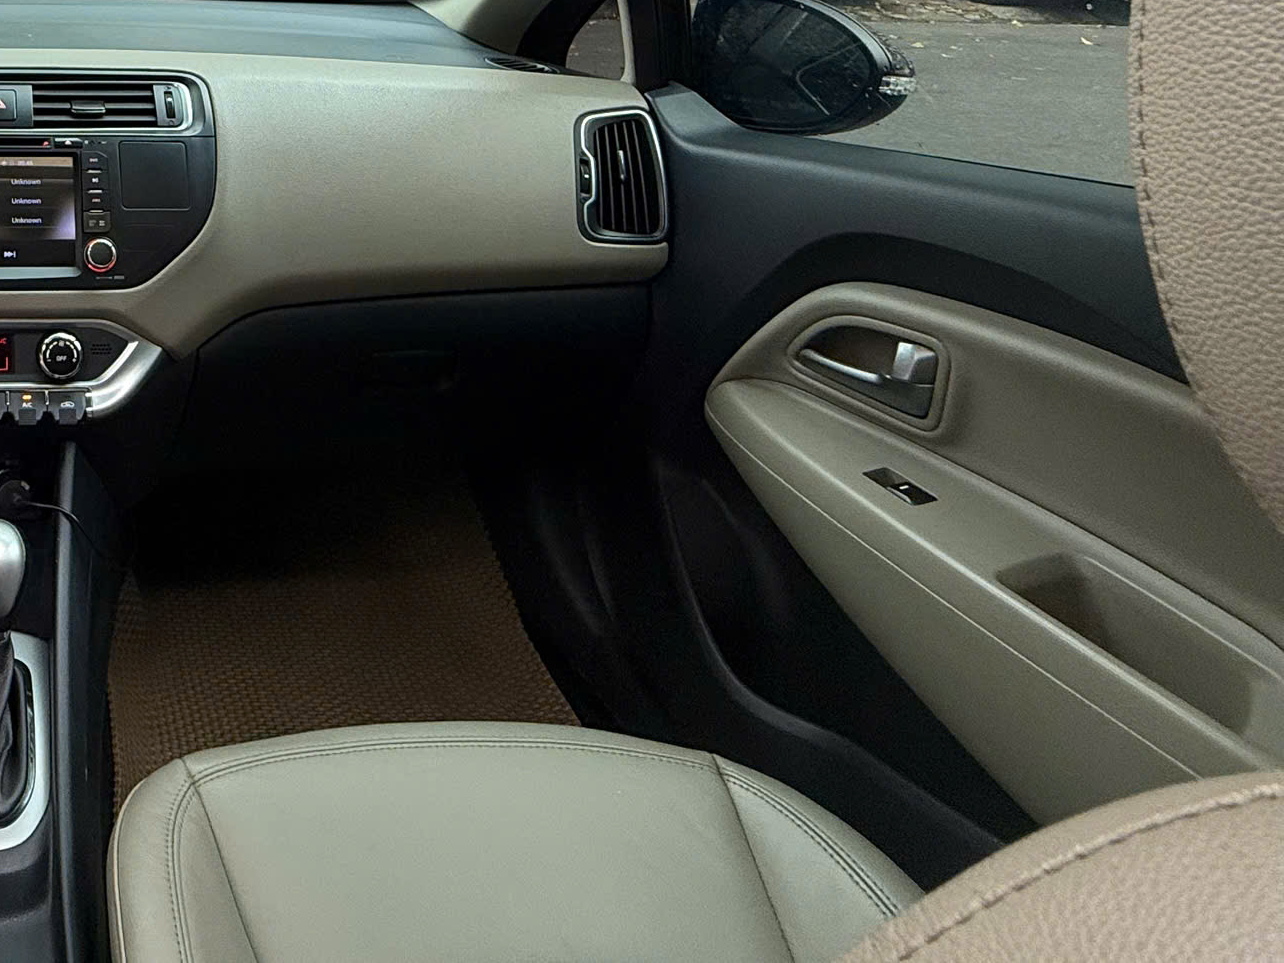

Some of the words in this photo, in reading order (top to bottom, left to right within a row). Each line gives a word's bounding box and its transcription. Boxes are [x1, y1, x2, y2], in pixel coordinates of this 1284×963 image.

[10, 178, 42, 186] Unknown
[11, 197, 42, 205] Unknown
[11, 216, 42, 224] Unknown
